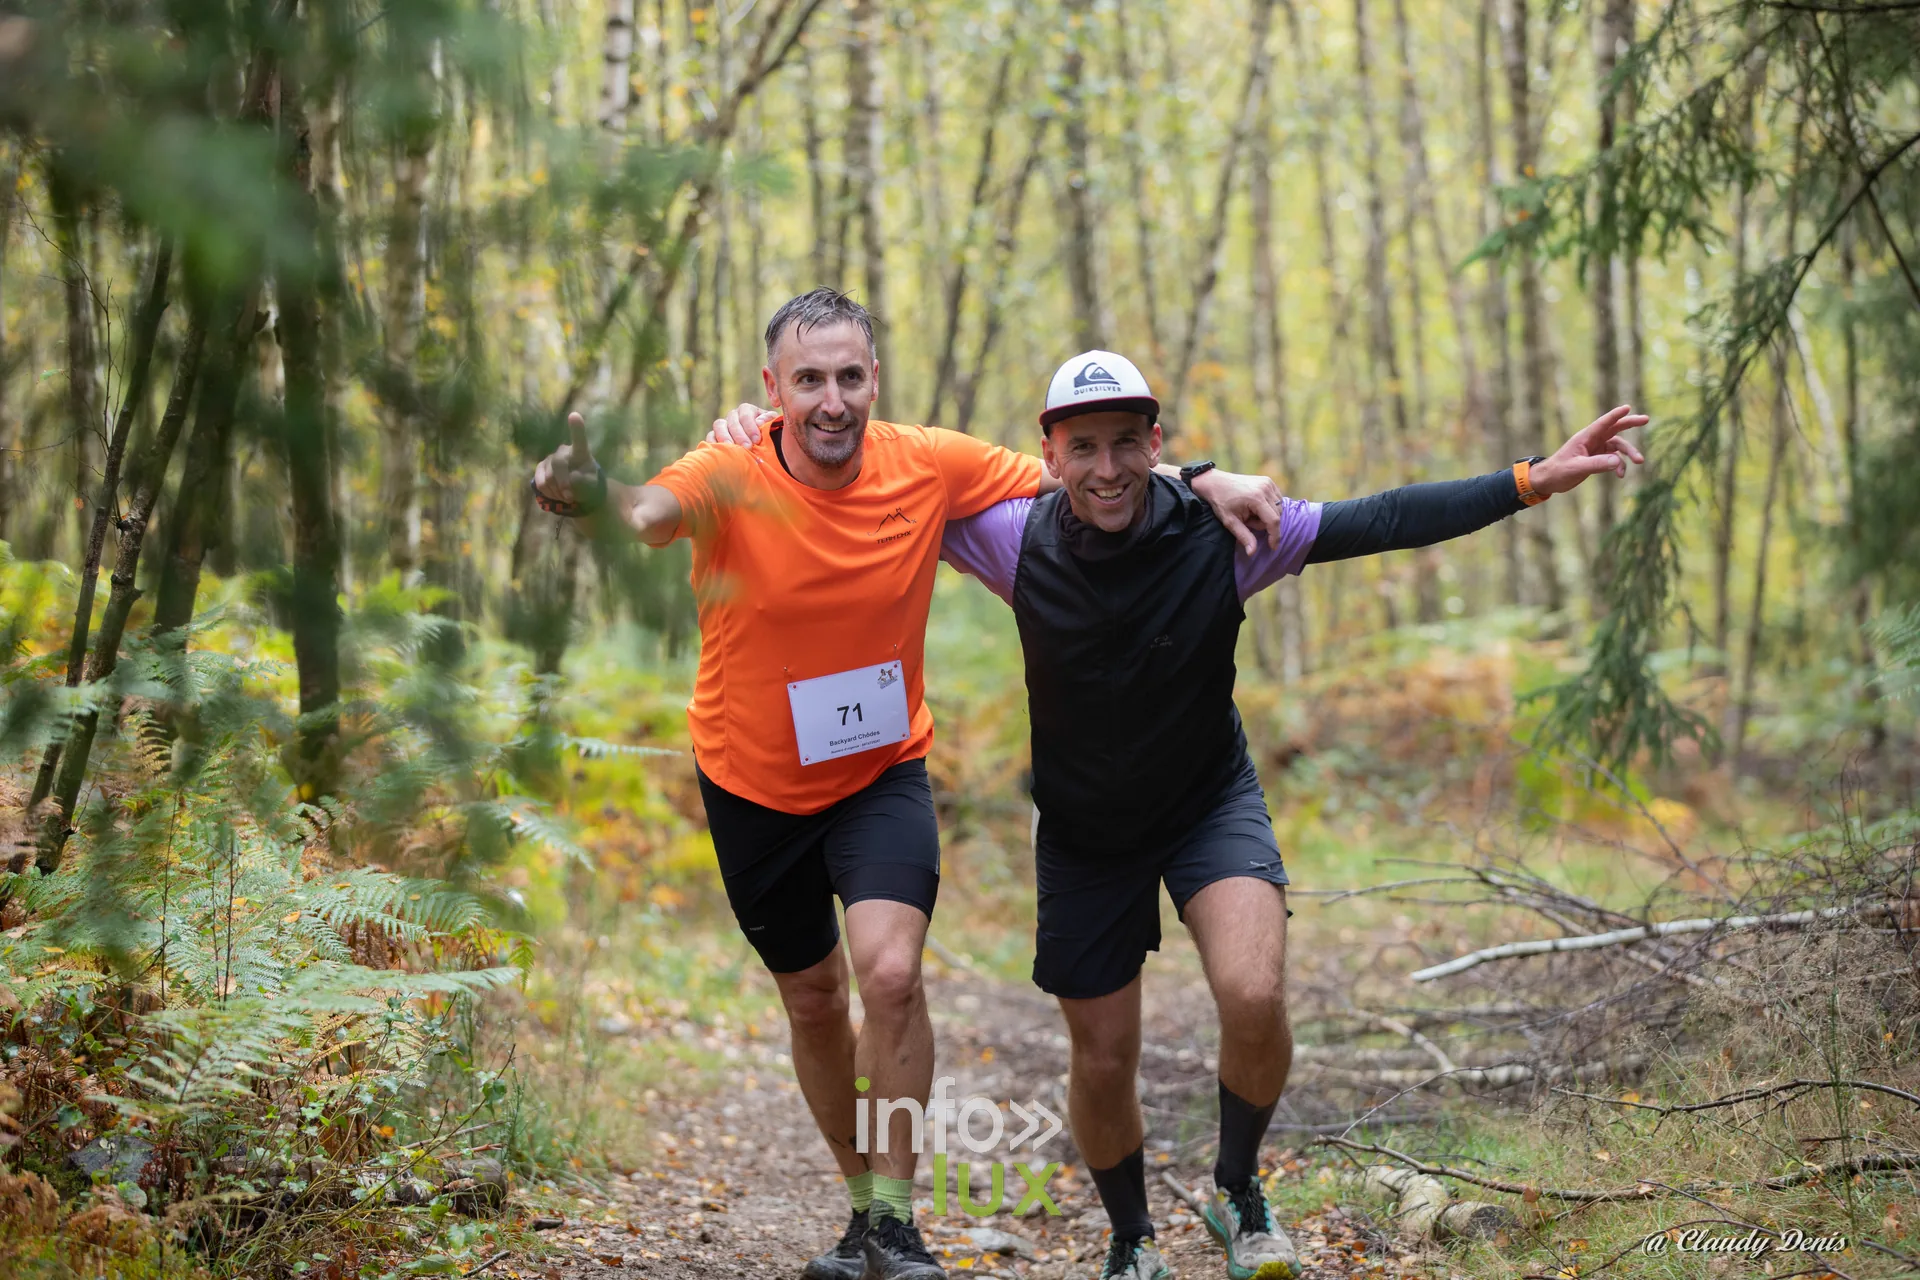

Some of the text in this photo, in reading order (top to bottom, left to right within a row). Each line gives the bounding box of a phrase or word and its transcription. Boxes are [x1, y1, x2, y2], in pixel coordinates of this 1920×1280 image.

[1074, 386, 1121, 395] QUIKSILVER
[877, 536, 895, 544] TEAM
[837, 702, 863, 726] 71
[829, 735, 857, 747] Backyard
